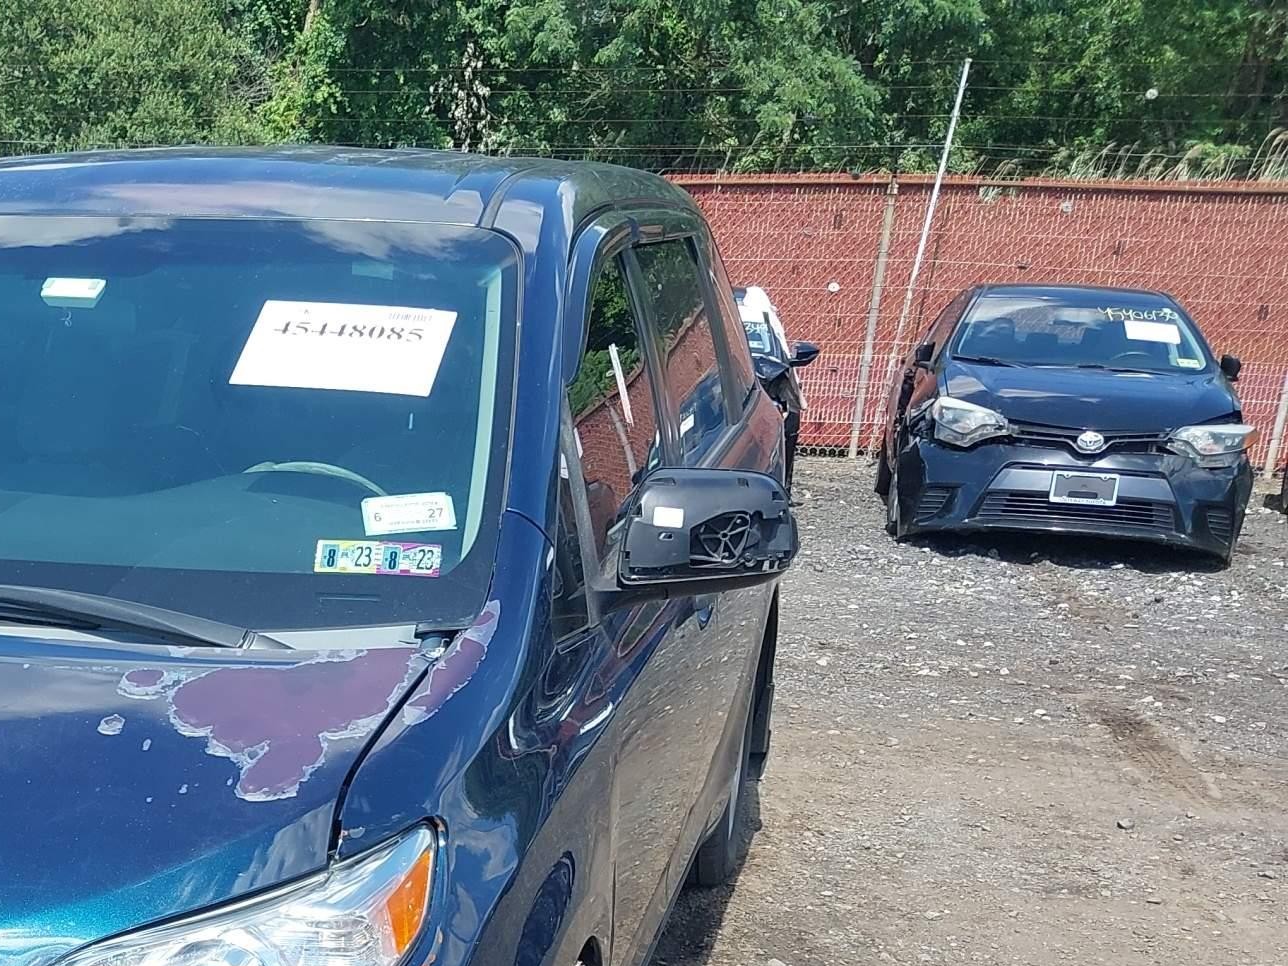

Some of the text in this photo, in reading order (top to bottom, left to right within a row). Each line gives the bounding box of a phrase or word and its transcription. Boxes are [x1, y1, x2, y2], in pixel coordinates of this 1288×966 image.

[273, 319, 425, 343] 45448085
[427, 507, 444, 519] 27
[327, 546, 373, 568] 8 23
[388, 548, 434, 570] 8 23
